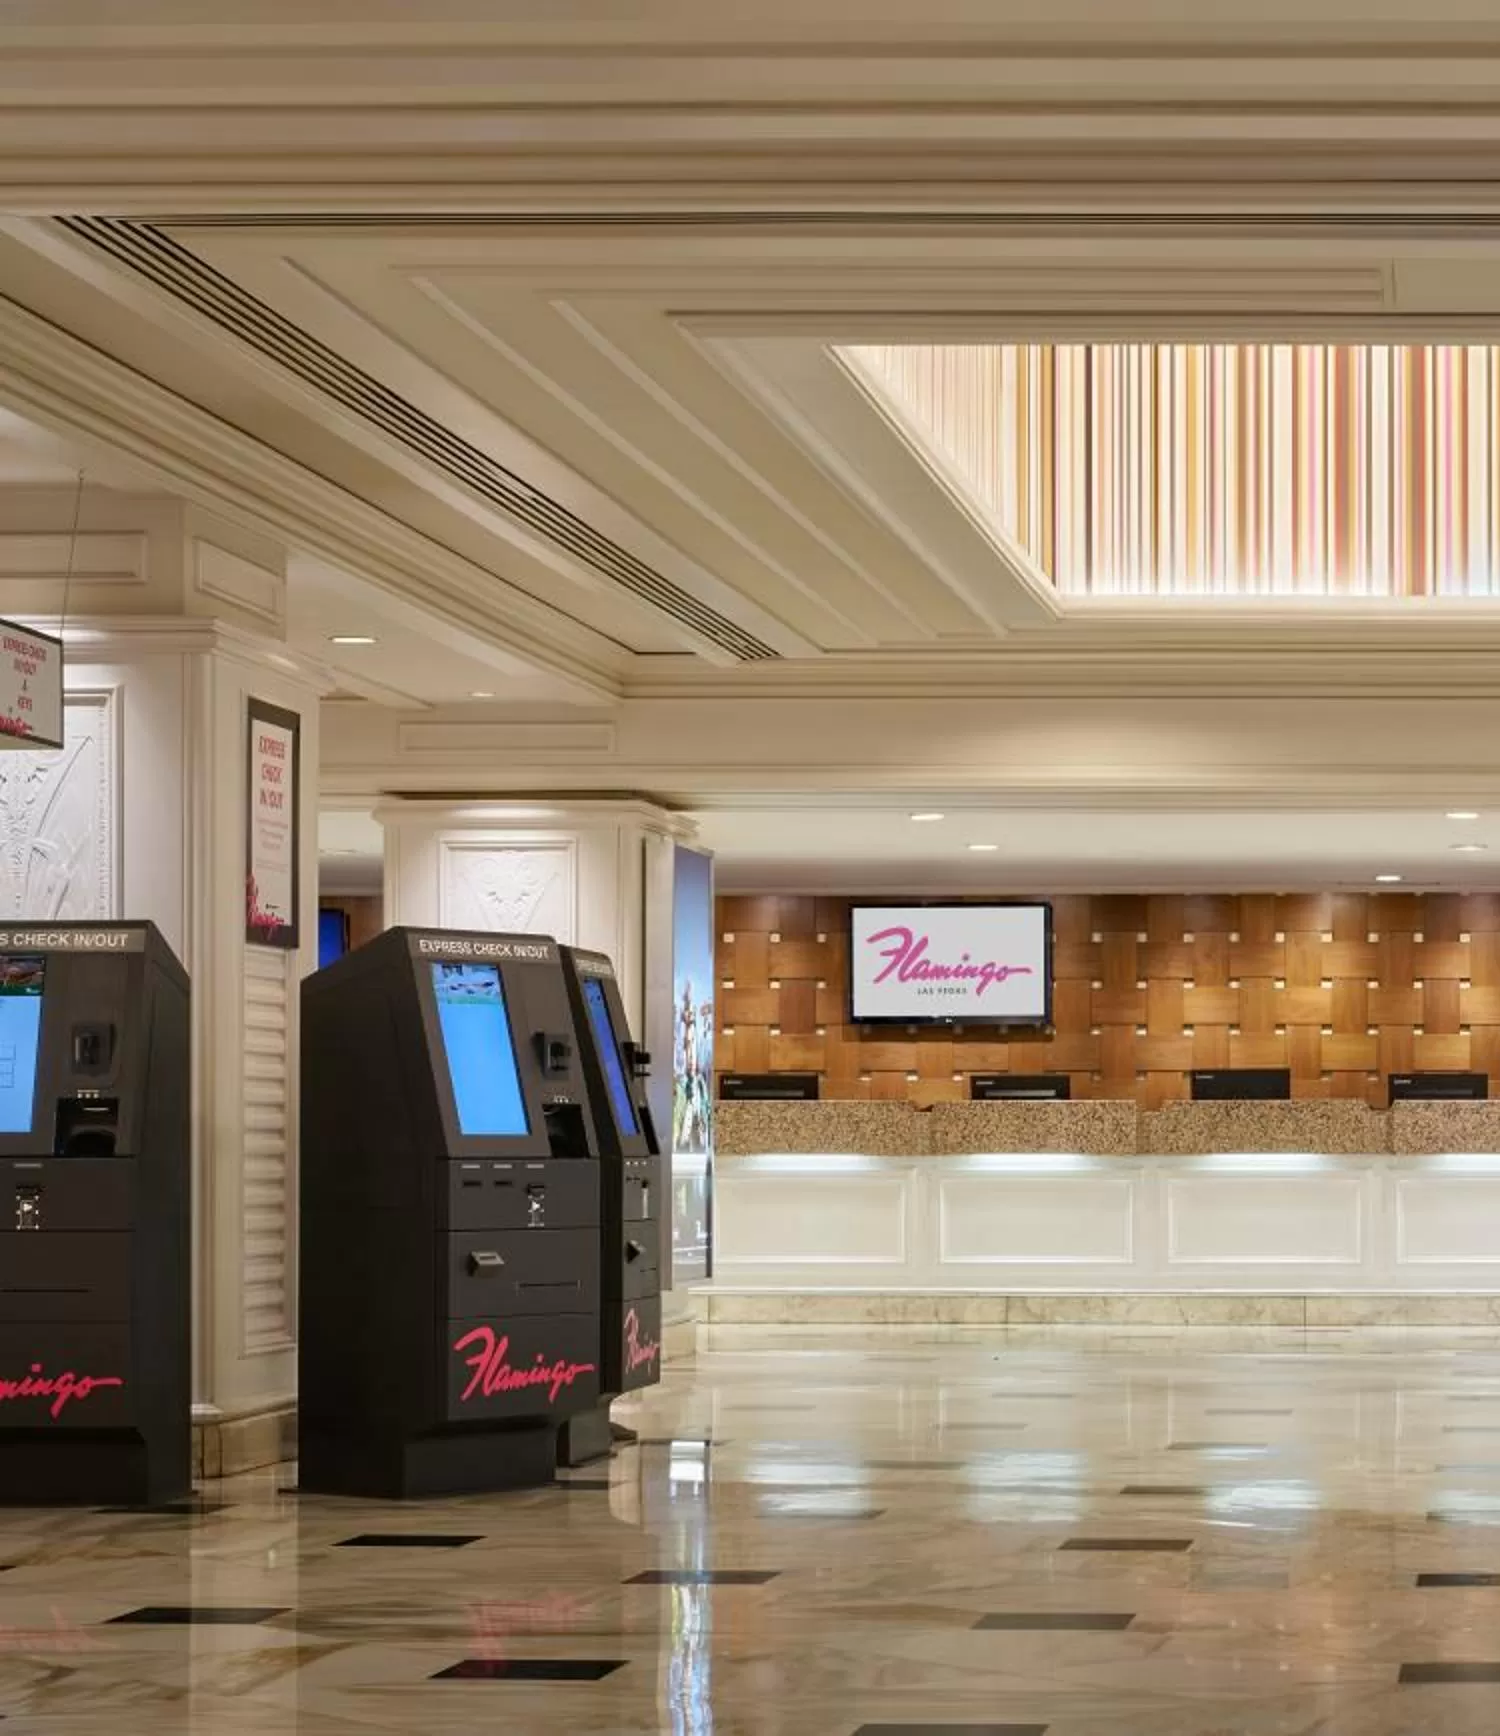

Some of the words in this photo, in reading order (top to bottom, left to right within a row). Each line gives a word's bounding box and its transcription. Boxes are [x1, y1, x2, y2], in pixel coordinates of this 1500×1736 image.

[13, 932, 70, 948] CHECK
[73, 932, 129, 948] IN/OUT
[419, 938, 473, 956] EXPRESS
[474, 943, 513, 957] CHECK
[867, 926, 1032, 996] Flamingo
[453, 1325, 595, 1404] Flamingo
